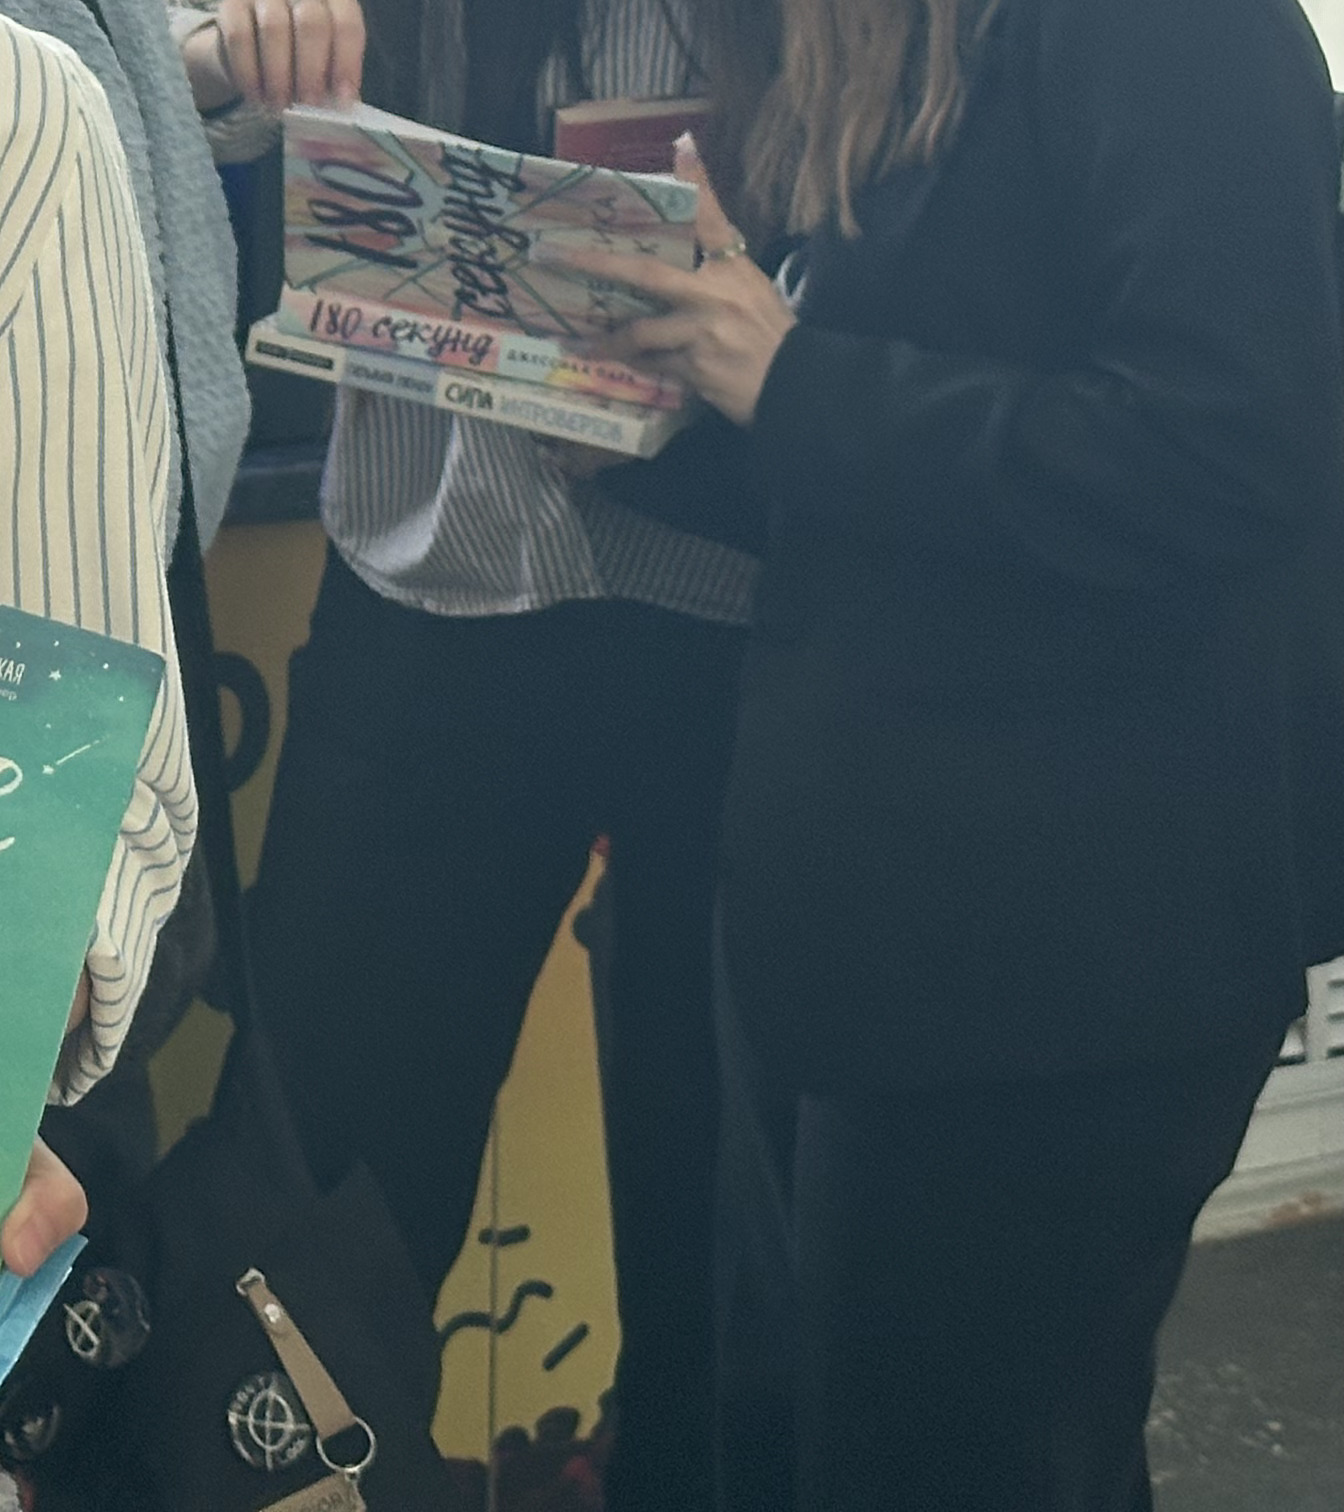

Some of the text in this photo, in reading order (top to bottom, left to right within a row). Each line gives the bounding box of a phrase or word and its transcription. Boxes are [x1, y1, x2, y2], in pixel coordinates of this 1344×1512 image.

[310, 298, 362, 339] 180
[372, 314, 494, 367] секунд
[444, 381, 494, 411] СИЛА
